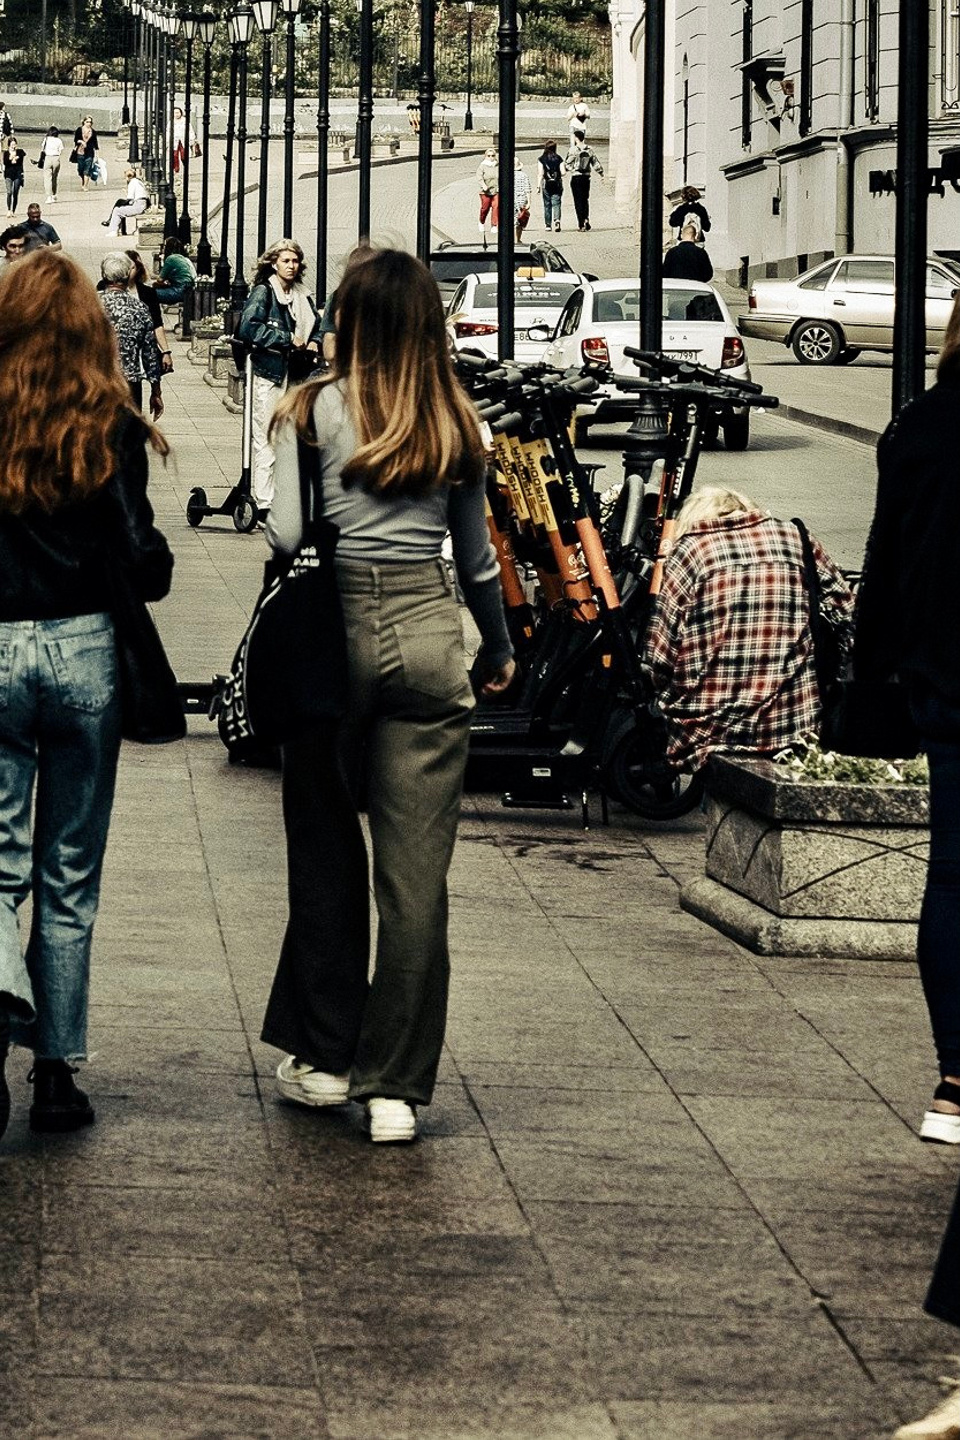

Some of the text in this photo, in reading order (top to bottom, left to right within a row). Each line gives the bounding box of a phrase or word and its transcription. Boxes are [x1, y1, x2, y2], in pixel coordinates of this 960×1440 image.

[497, 442, 518, 492] WHOOSH
[512, 446, 533, 497] WHOOSH
[525, 451, 547, 503] WHOOSH
